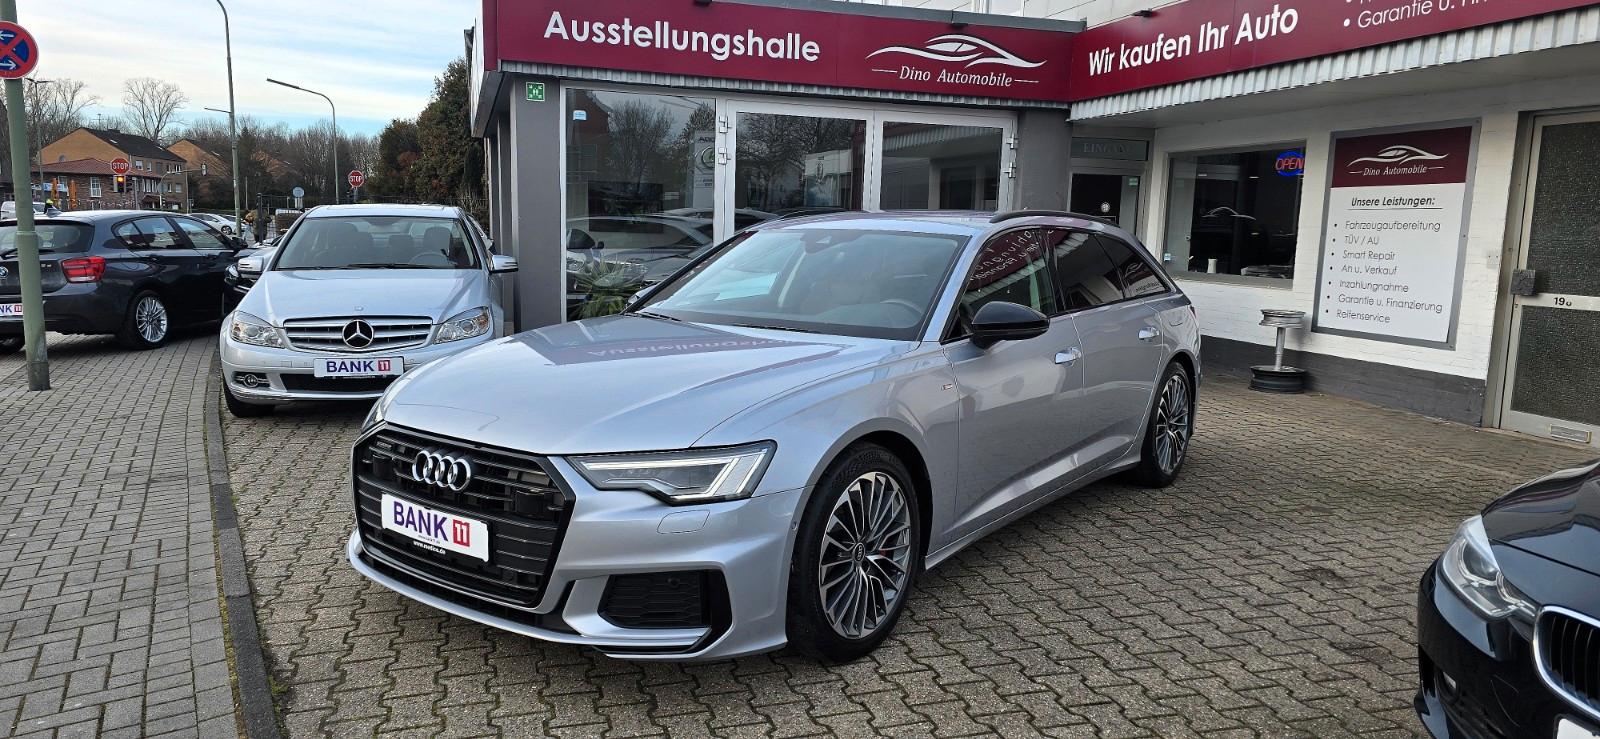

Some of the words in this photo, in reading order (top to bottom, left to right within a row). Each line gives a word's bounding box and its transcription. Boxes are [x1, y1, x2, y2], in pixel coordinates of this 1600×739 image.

[1358, 1, 1432, 28] Garantie
[544, 11, 820, 61] Ausstellungshalle
[1089, 48, 1115, 76] Wir
[1119, 33, 1190, 70] kaufen
[1198, 21, 1228, 53] Ihr
[1234, 4, 1299, 46] Auto
[900, 66, 931, 81] Dino
[937, 69, 1012, 87] Automobile
[112, 162, 129, 170] STOP
[1275, 157, 1304, 171] OPEN
[1363, 167, 1380, 176] Dino
[1383, 164, 1428, 175] Automobile
[350, 175, 362, 183] STOP
[1351, 197, 1380, 207] Unsere
[1382, 196, 1436, 208] Leistungen:
[1345, 220, 1441, 232] Fahrzeugaufbereitung
[1344, 234, 1359, 244] TÜV
[1360, 235, 1366, 246] /
[1367, 236, 1380, 245] AU
[1342, 250, 1366, 259] Smart
[1368, 251, 1396, 261] Repair
[1341, 264, 1353, 273] An
[1365, 265, 1398, 275] Verkauf
[1339, 280, 1409, 293] Inzahlungnahme
[1338, 294, 1375, 306] Garantie
[1386, 298, 1443, 314] Finanzierung
[1336, 309, 1391, 323] Reifenservice
[326, 360, 374, 373] BANK
[378, 360, 390, 371] 11
[393, 501, 448, 541] BANK
[453, 520, 470, 547] 11
